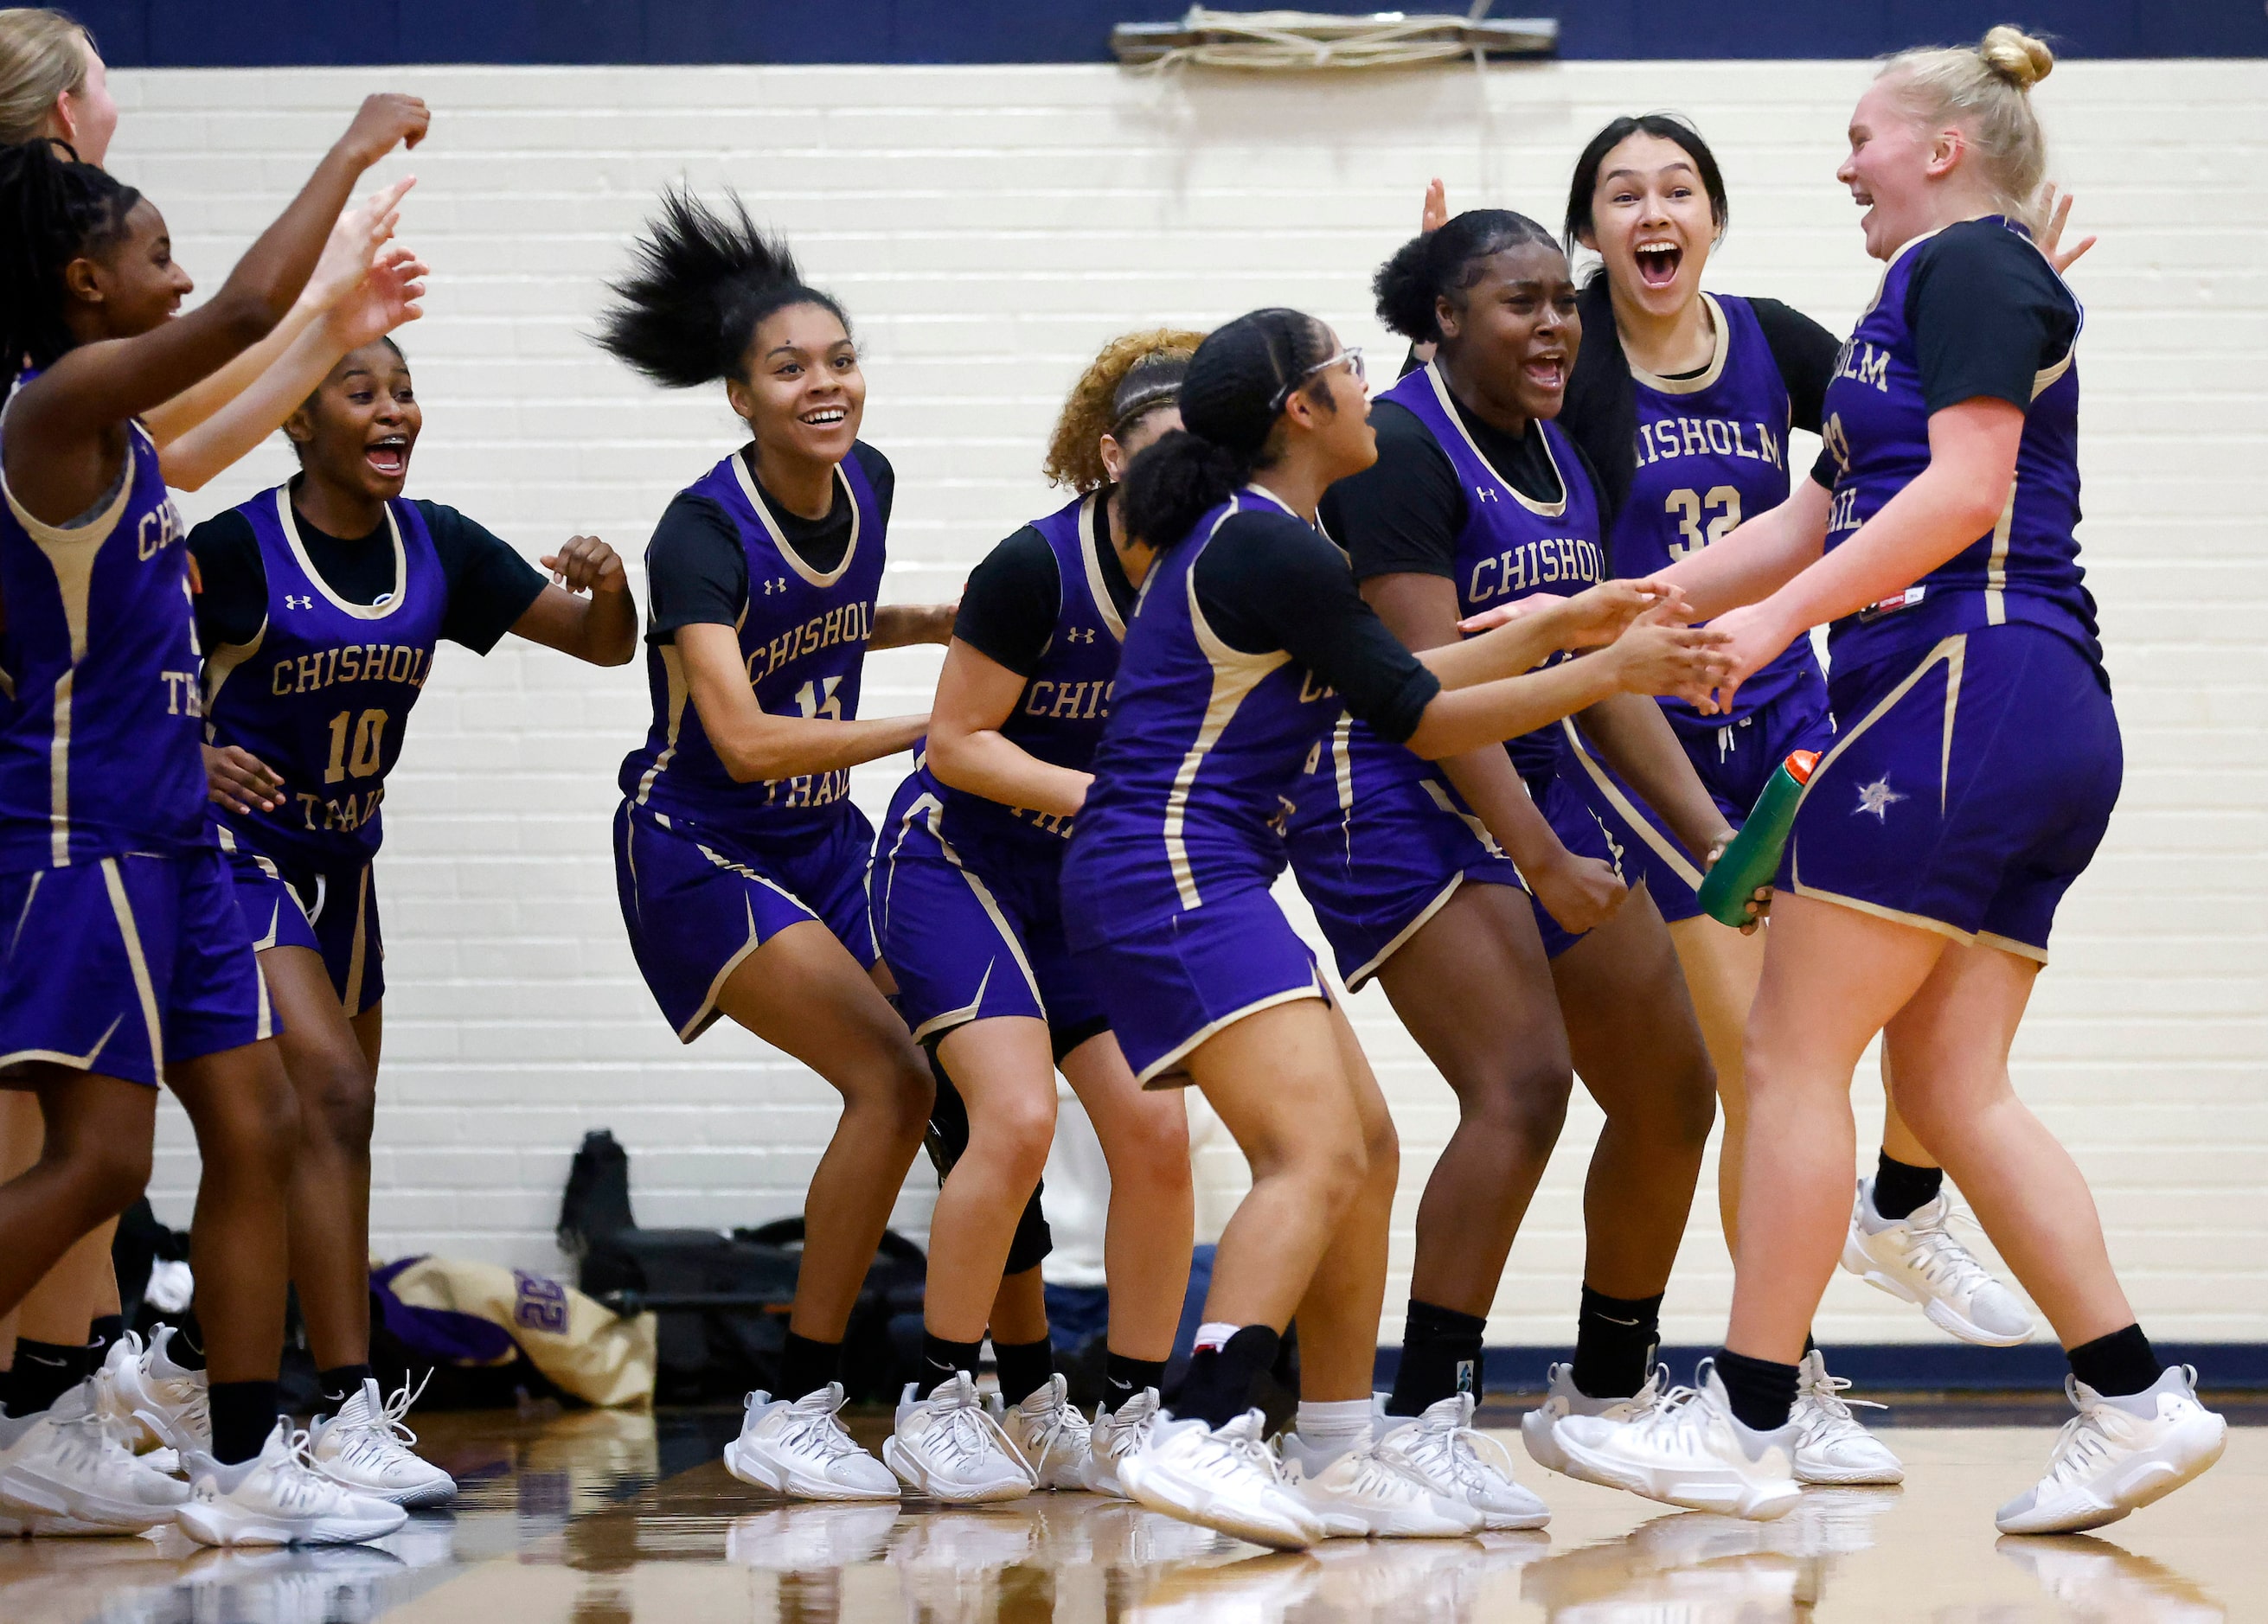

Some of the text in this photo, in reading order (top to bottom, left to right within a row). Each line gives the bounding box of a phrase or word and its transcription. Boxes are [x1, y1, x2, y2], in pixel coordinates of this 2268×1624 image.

[1634, 418, 1783, 471] ISHOLM
[1665, 485, 1741, 563] 32
[1469, 538, 1605, 603] CHISHOL
[746, 601, 875, 687] CHISHOL
[324, 708, 388, 783] 10
